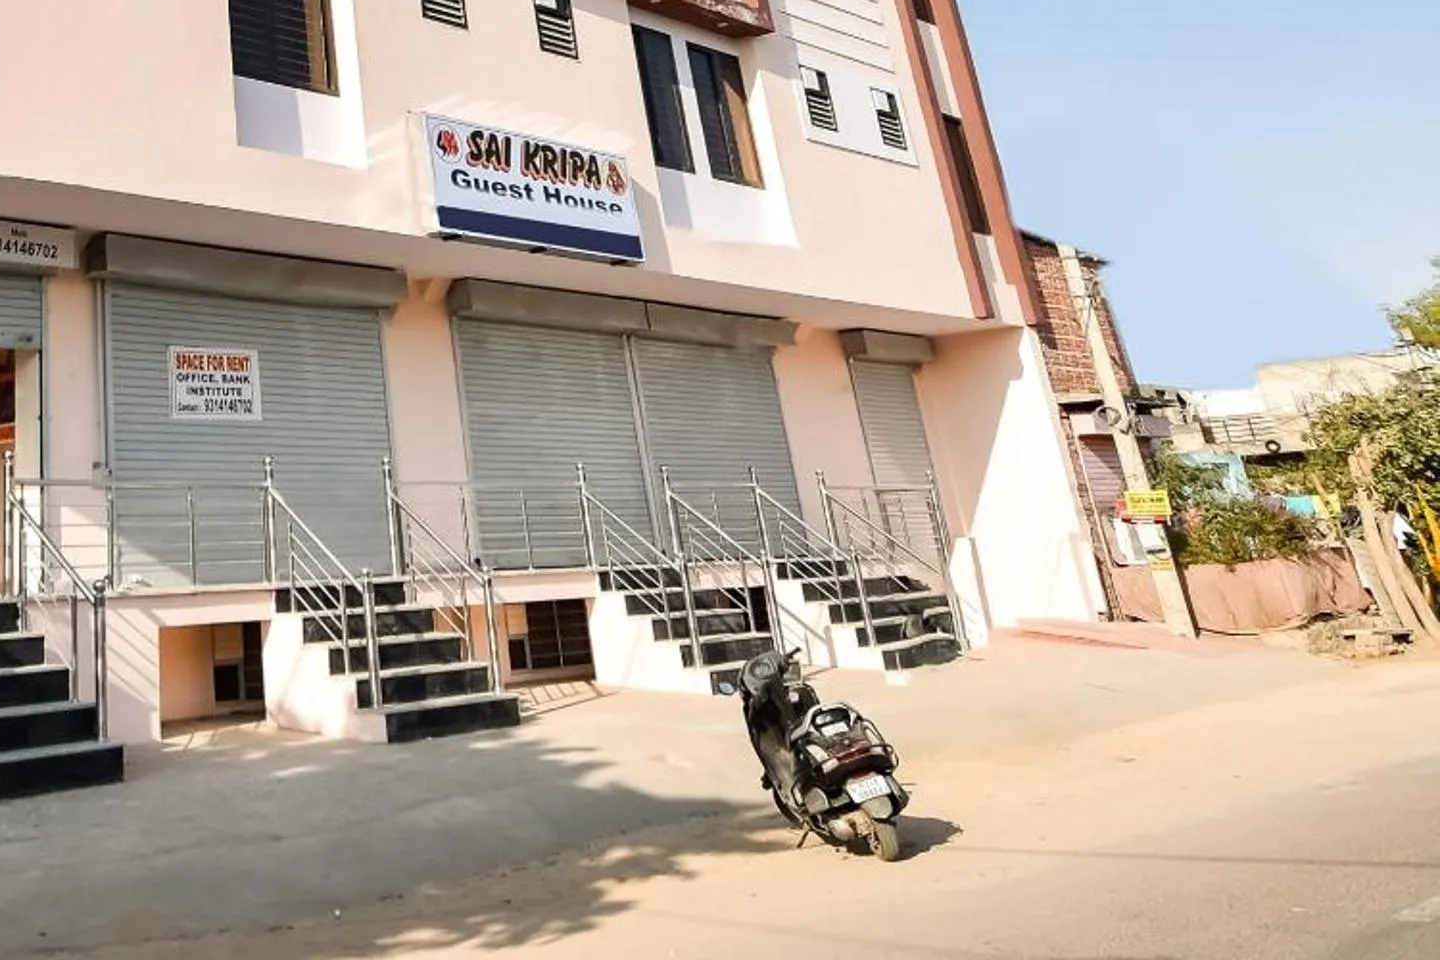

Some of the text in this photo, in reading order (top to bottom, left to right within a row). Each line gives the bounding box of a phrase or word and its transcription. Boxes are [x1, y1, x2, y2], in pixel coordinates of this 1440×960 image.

[466, 129, 602, 190] SAI KRIPA
[450, 168, 623, 214] Guest House
[175, 353, 250, 373] SPACE FOR RENT
[186, 386, 242, 397] INSTITUTE
